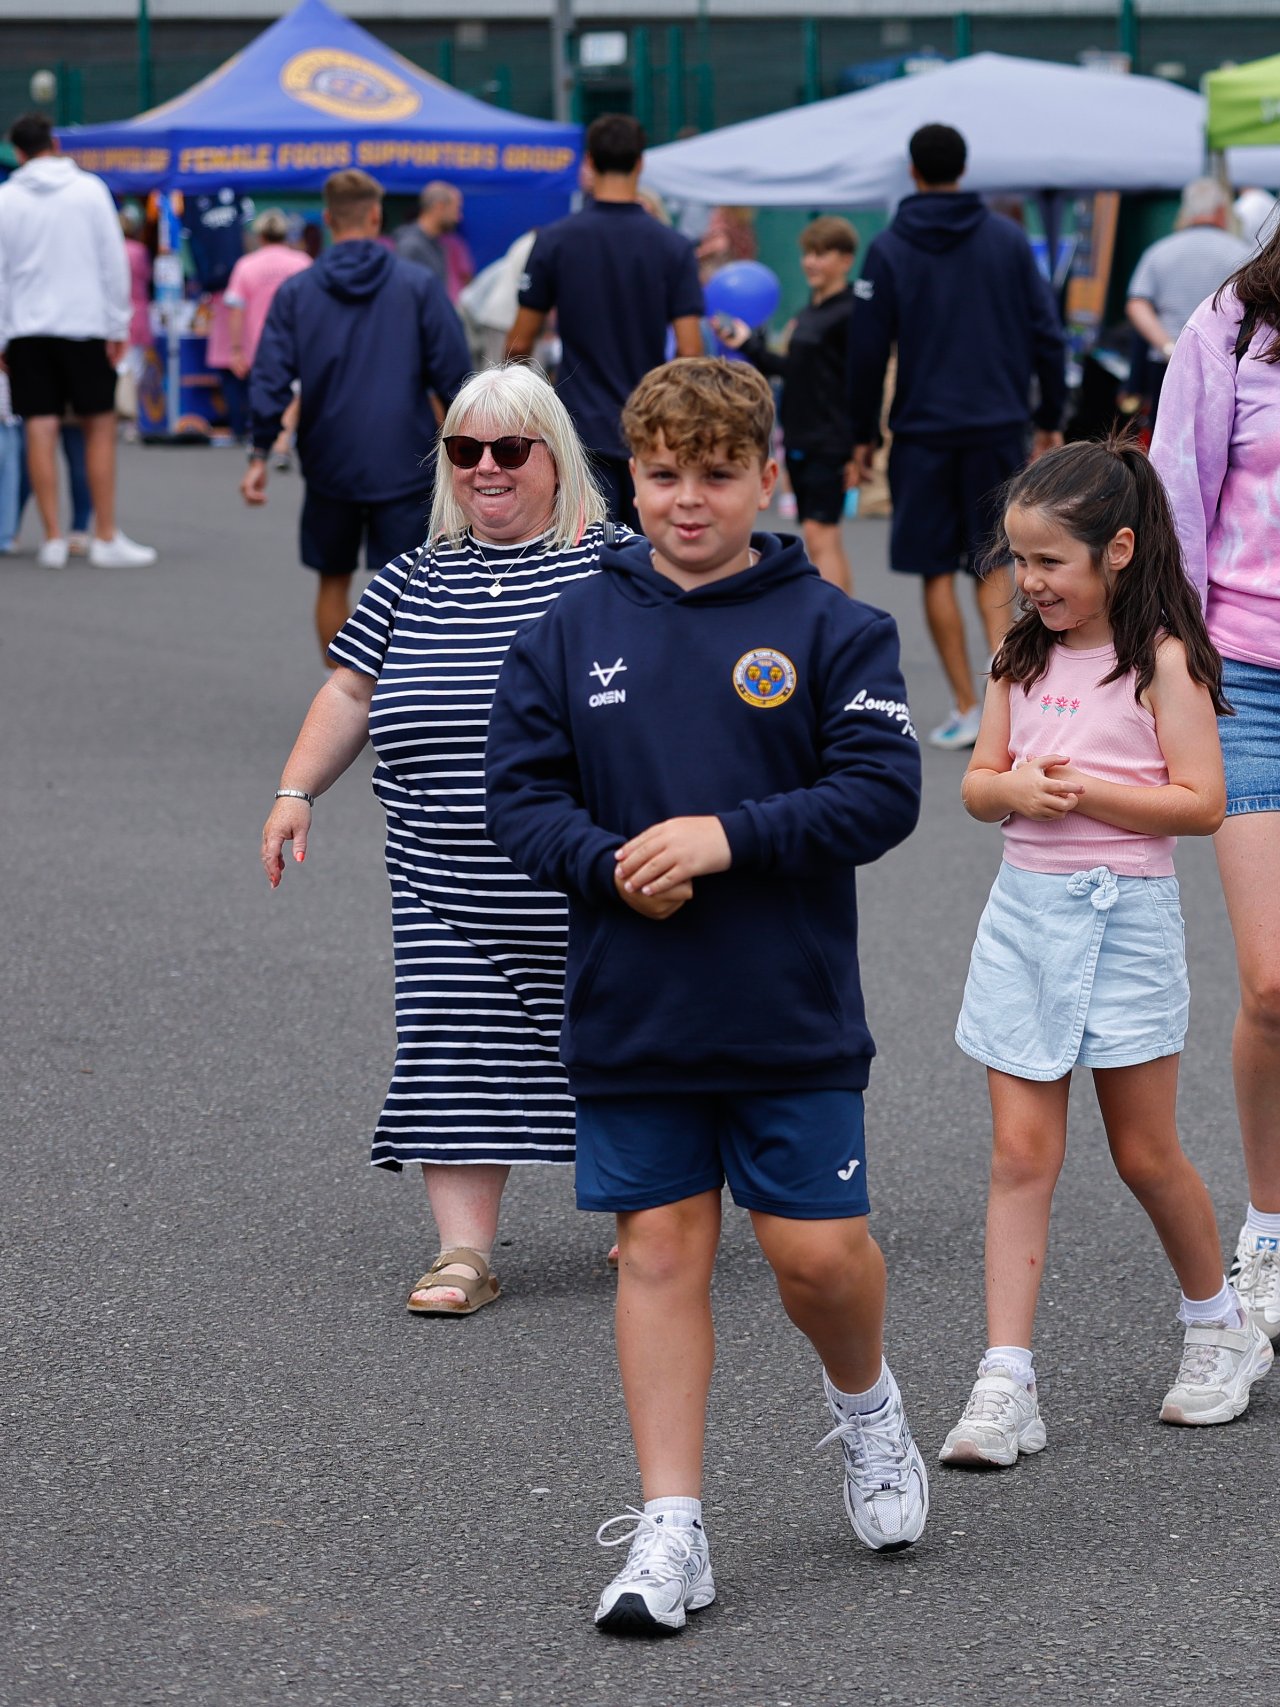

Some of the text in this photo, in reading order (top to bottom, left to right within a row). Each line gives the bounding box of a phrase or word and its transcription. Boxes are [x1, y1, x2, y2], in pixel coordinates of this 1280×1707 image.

[178, 143, 272, 173] FEMALE
[277, 141, 351, 169] FOCUS
[357, 140, 499, 170] SUPPORTERS
[502, 145, 575, 172] GROUP
[588, 688, 626, 708] OXEN
